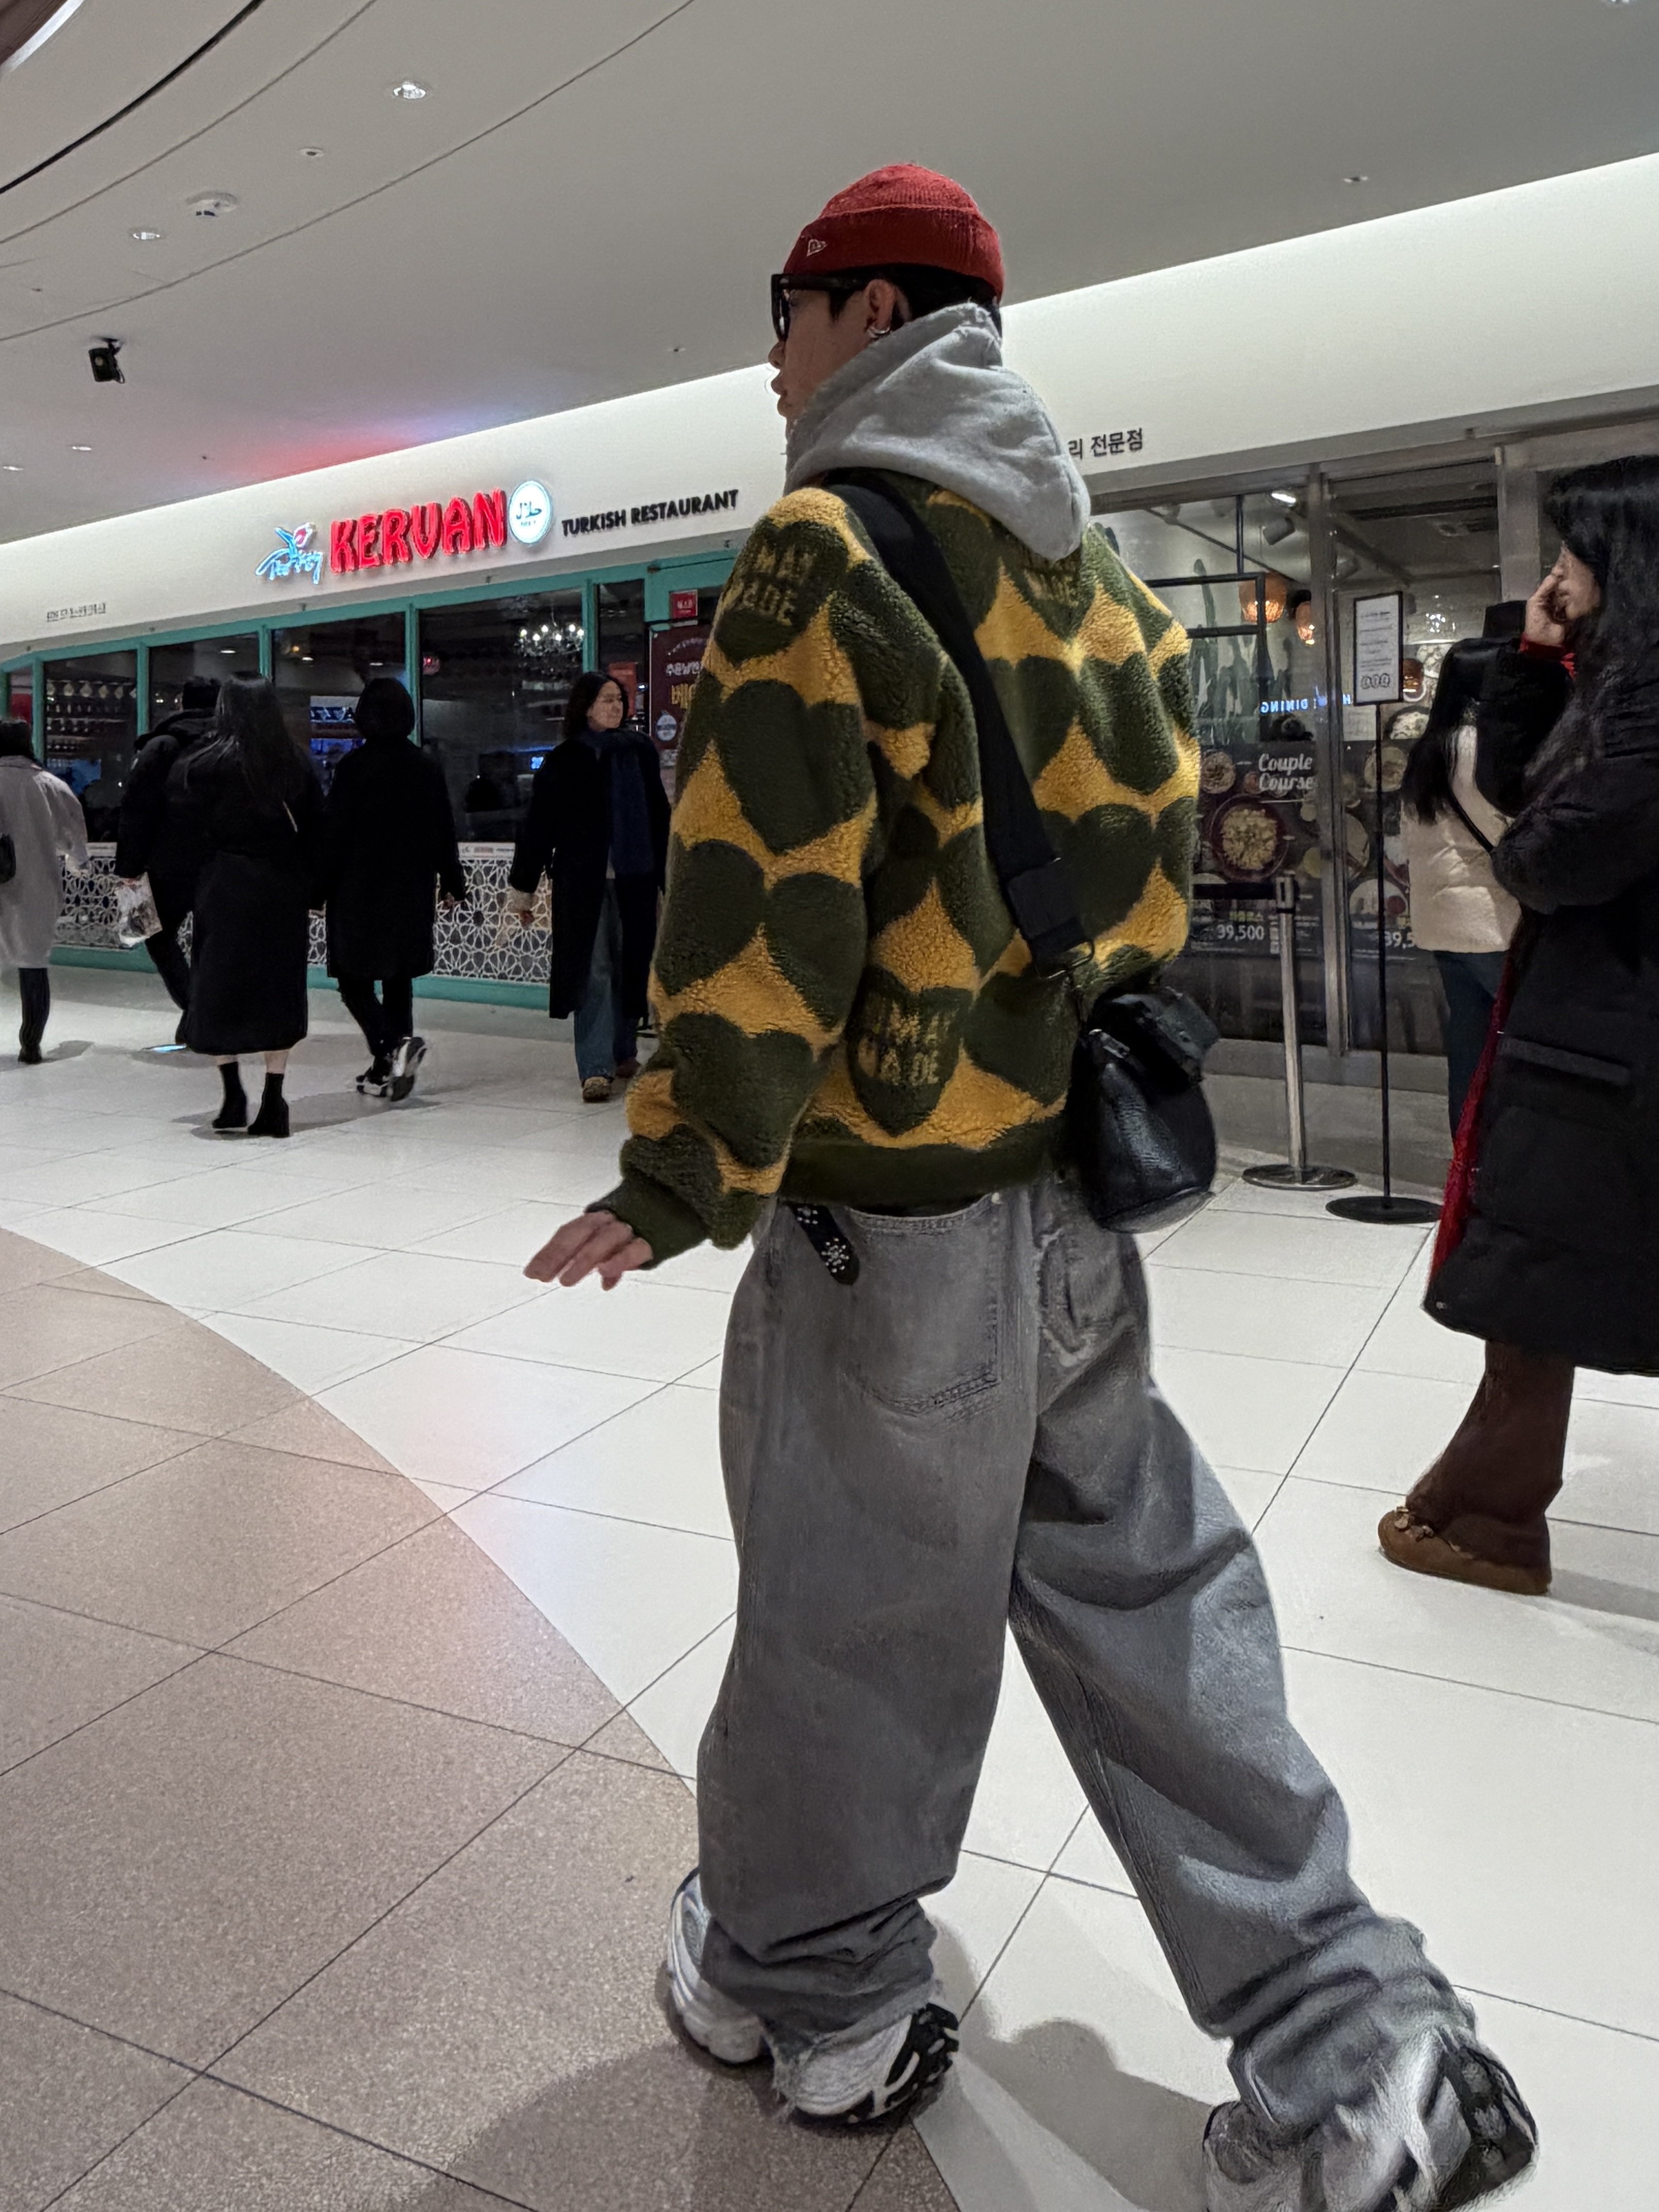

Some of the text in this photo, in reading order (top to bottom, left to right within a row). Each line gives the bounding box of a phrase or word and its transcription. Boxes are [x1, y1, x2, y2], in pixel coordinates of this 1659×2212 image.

[1067, 428, 1143, 460] 리 전문점
[561, 489, 739, 537] TURKISH RESTAURANT
[330, 487, 508, 574] KERVAN
[1259, 753, 1313, 776] Couple
[1259, 773, 1315, 791] Course
[1217, 924, 1265, 941] 39,500
[1384, 931, 1416, 949] 39,5
